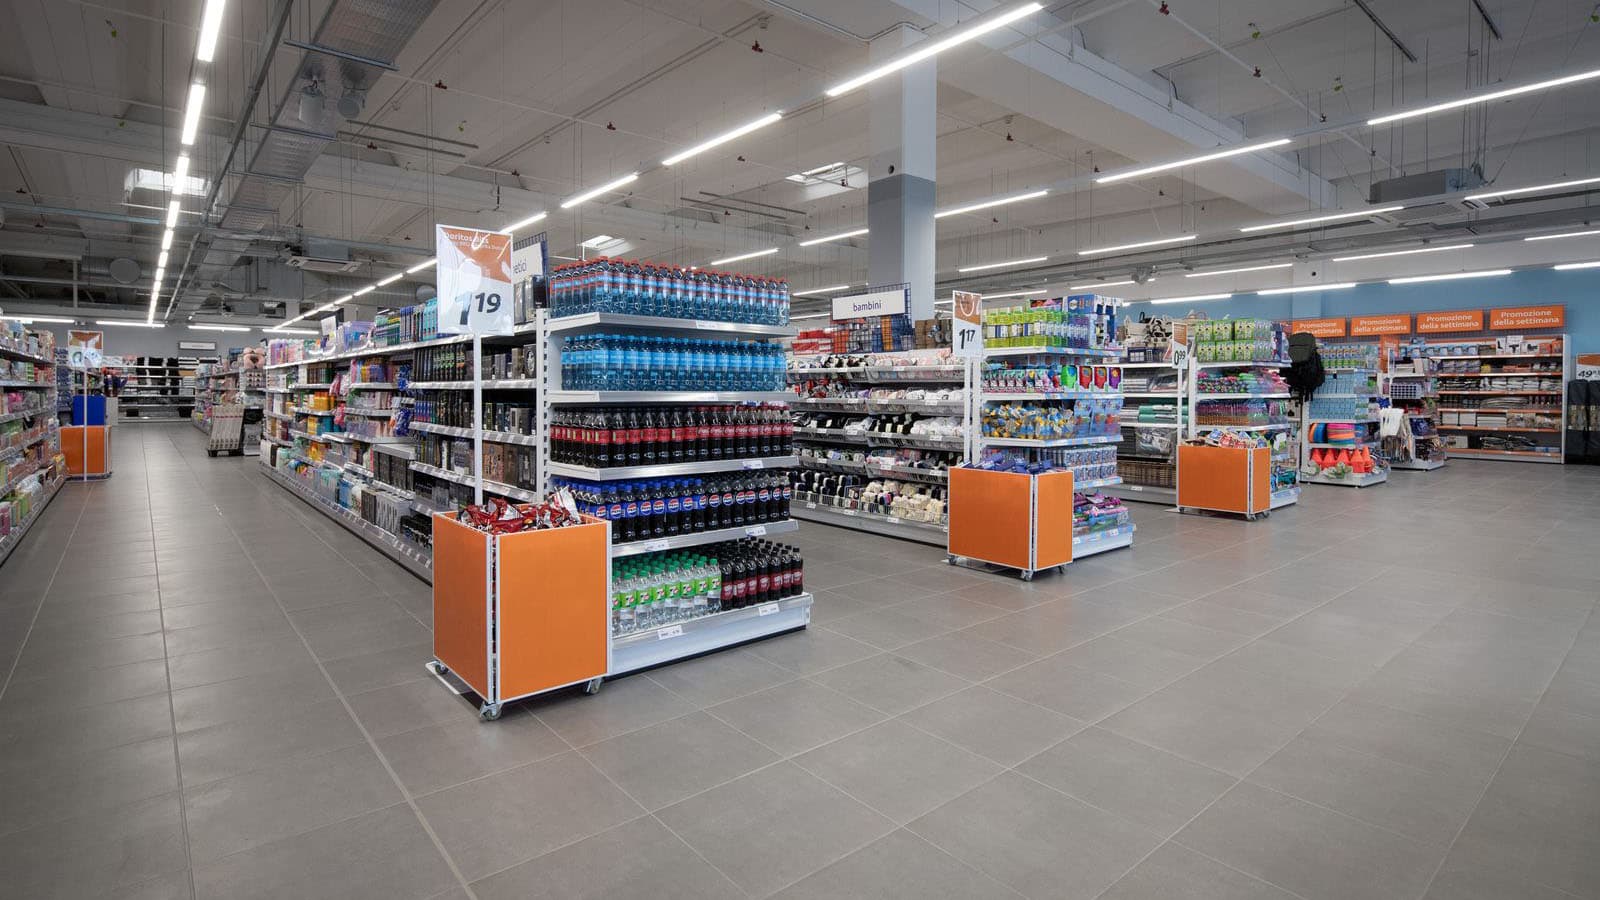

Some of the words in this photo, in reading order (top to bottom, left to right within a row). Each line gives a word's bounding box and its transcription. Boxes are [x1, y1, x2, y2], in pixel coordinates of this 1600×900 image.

[853, 300, 882, 312] bambini
[1426, 313, 1472, 322] Promozione
[1501, 310, 1552, 318] Promozione
[1420, 321, 1439, 330] della
[1440, 320, 1479, 329] settimana
[1493, 318, 1514, 326] della
[1516, 316, 1559, 325] settimana
